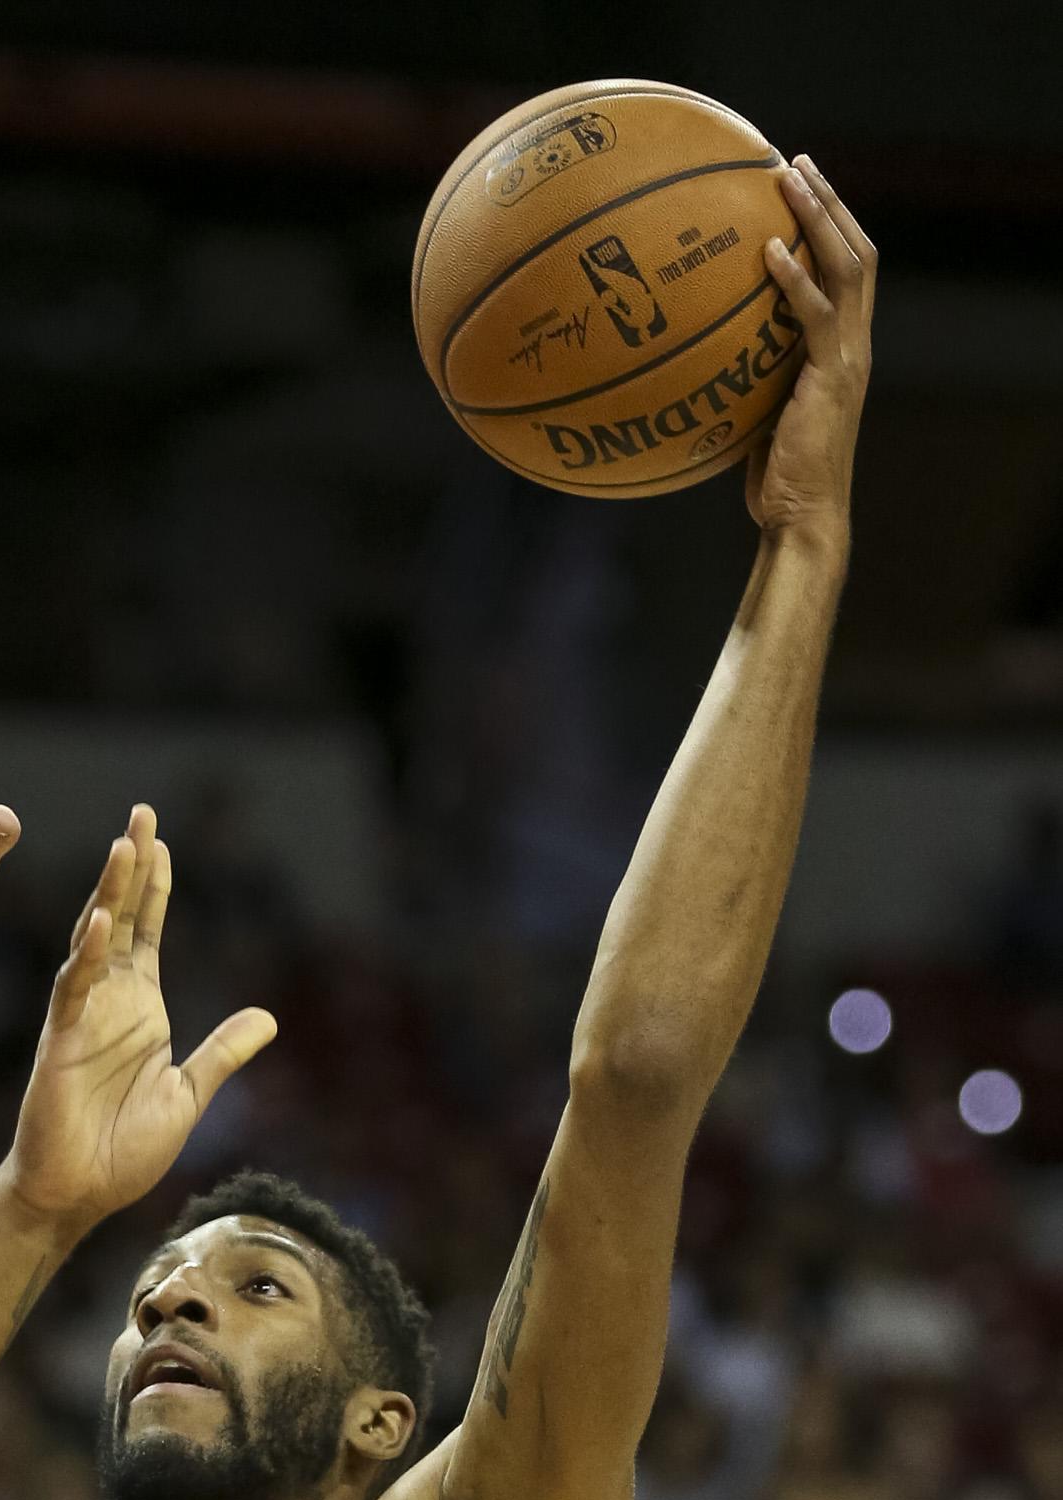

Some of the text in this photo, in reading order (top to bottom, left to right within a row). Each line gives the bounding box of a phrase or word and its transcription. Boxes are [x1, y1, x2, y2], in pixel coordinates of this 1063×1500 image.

[594, 239, 622, 265] NBA
[655, 226, 741, 286] OFFICIAL GAME BALL
[543, 290, 805, 471] SPALDING
